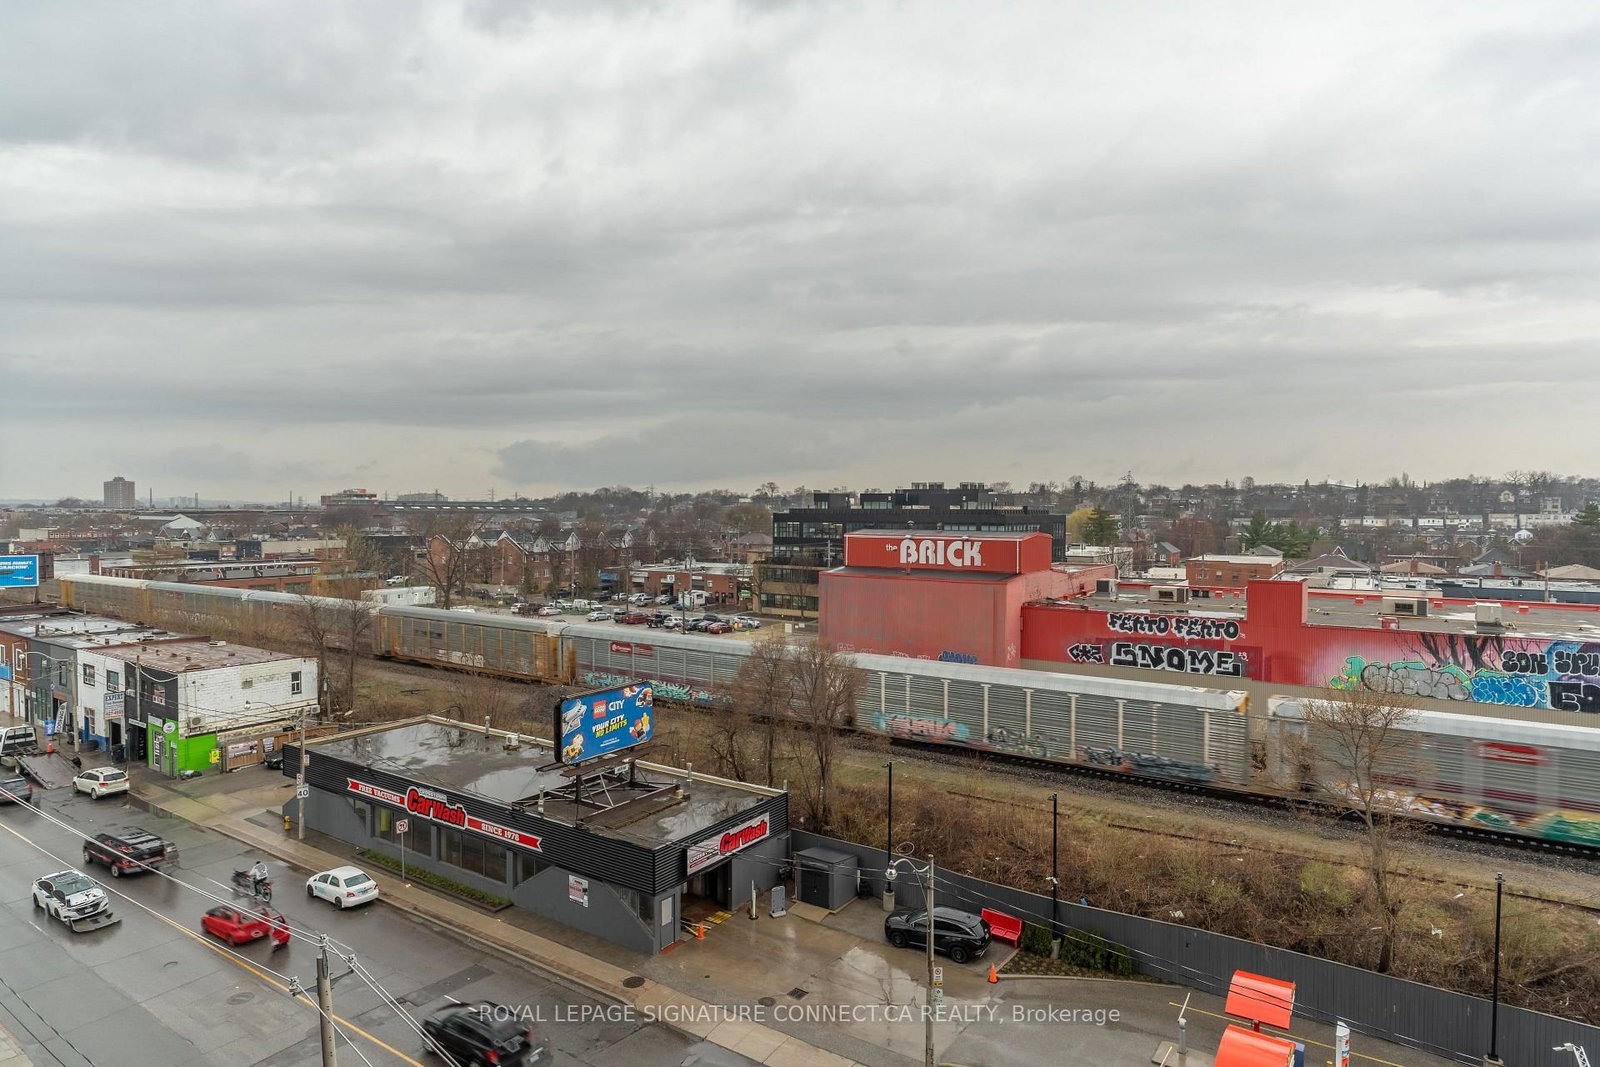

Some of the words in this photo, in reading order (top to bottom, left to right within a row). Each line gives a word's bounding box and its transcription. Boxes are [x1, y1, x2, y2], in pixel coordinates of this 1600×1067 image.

[886, 544, 898, 552] the
[900, 539, 981, 566] BRICK
[608, 699, 625, 712] CITY
[592, 720, 610, 733] YOUR
[610, 714, 625, 725] CITY
[596, 729, 605, 738] NO
[605, 719, 628, 734] LIMITS
[358, 784, 373, 795] FREE
[373, 788, 400, 803] VACUUMS
[481, 823, 503, 836] SINCE
[504, 830, 520, 842] 1978
